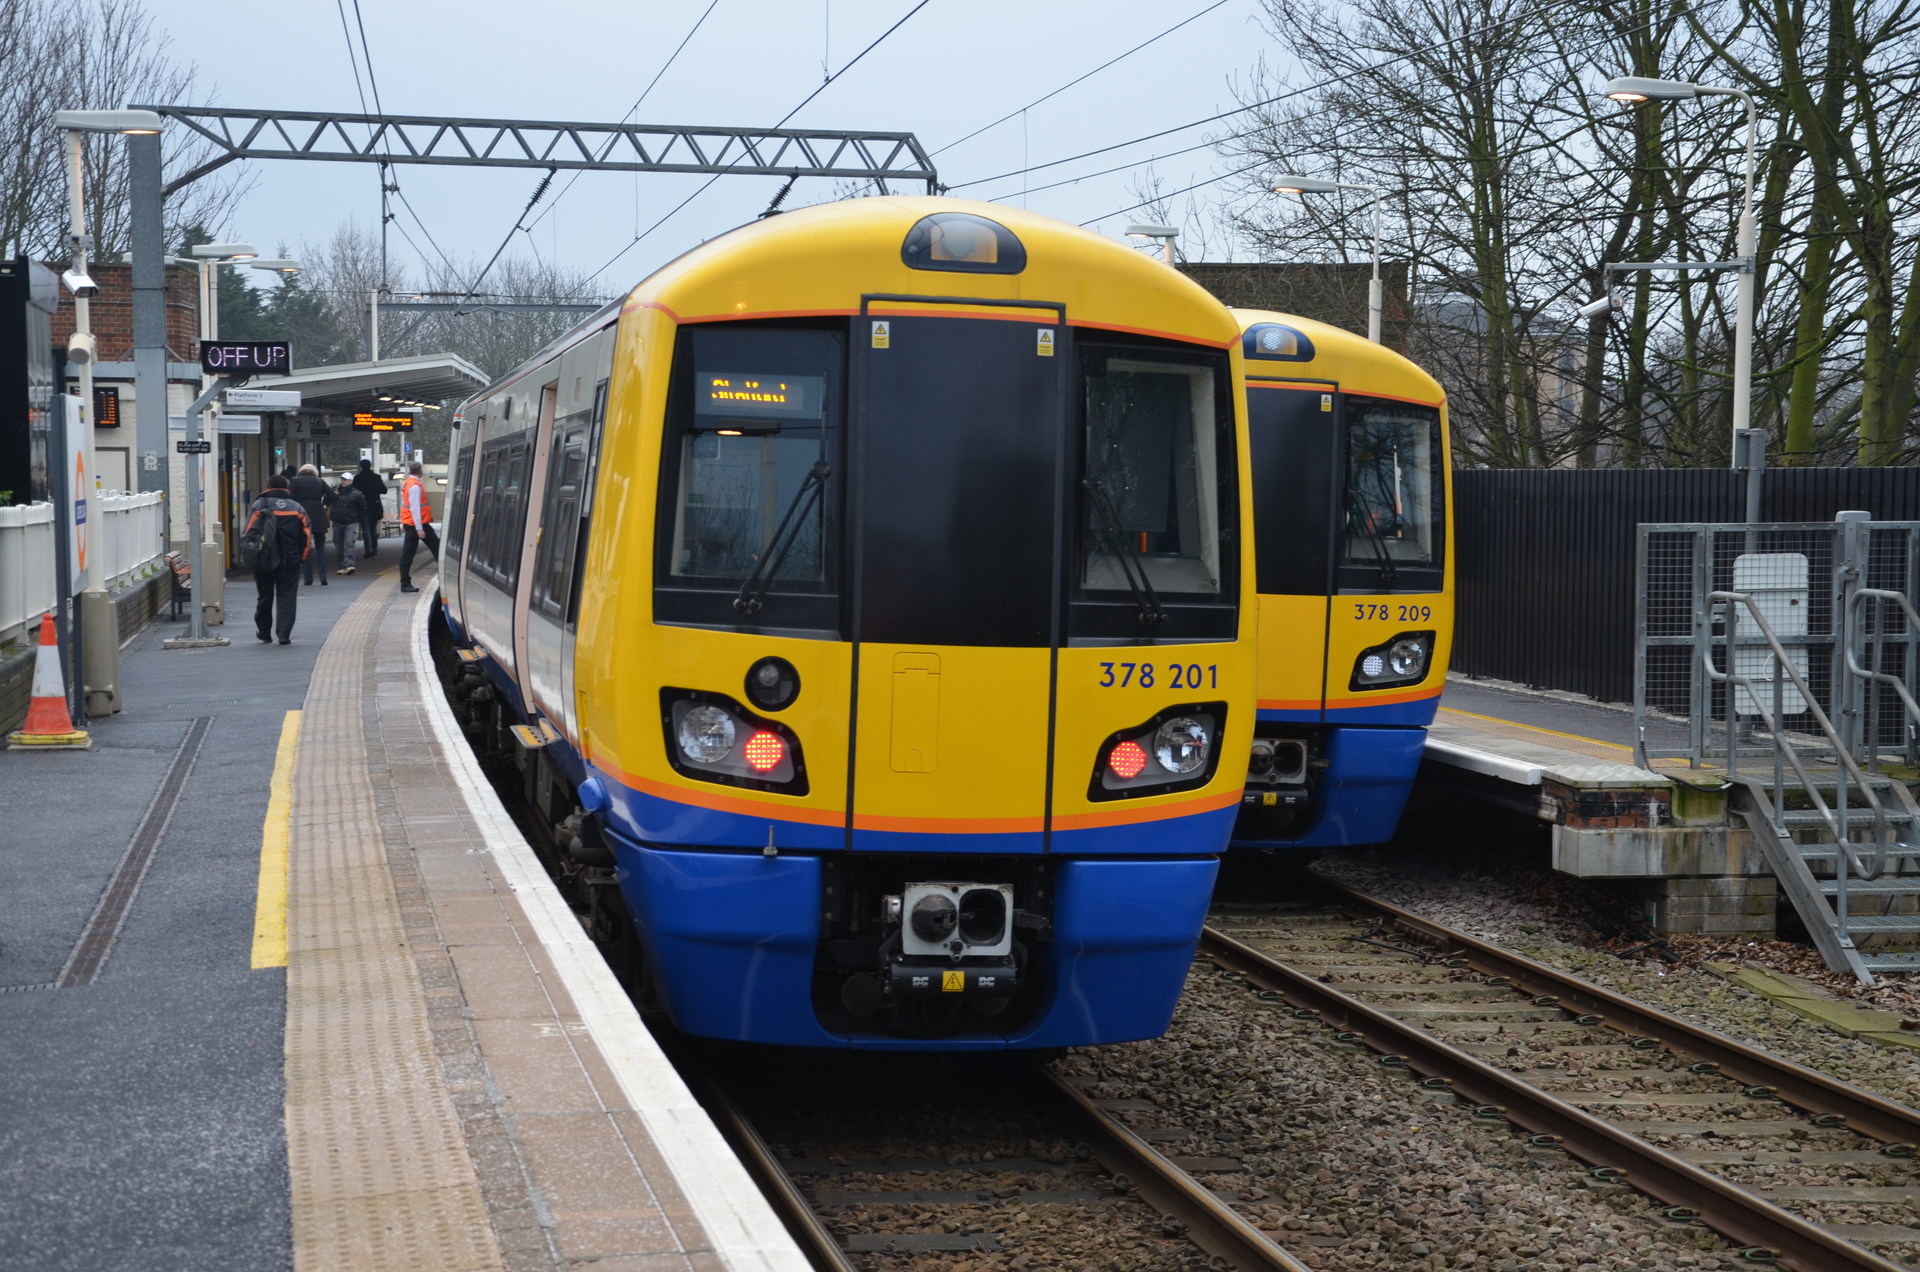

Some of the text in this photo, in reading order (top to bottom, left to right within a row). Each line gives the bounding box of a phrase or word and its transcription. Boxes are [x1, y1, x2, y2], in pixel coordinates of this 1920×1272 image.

[208, 346, 286, 367] OFF UP
[1354, 603, 1431, 622] 378 209
[1099, 662, 1217, 690] 378 201
